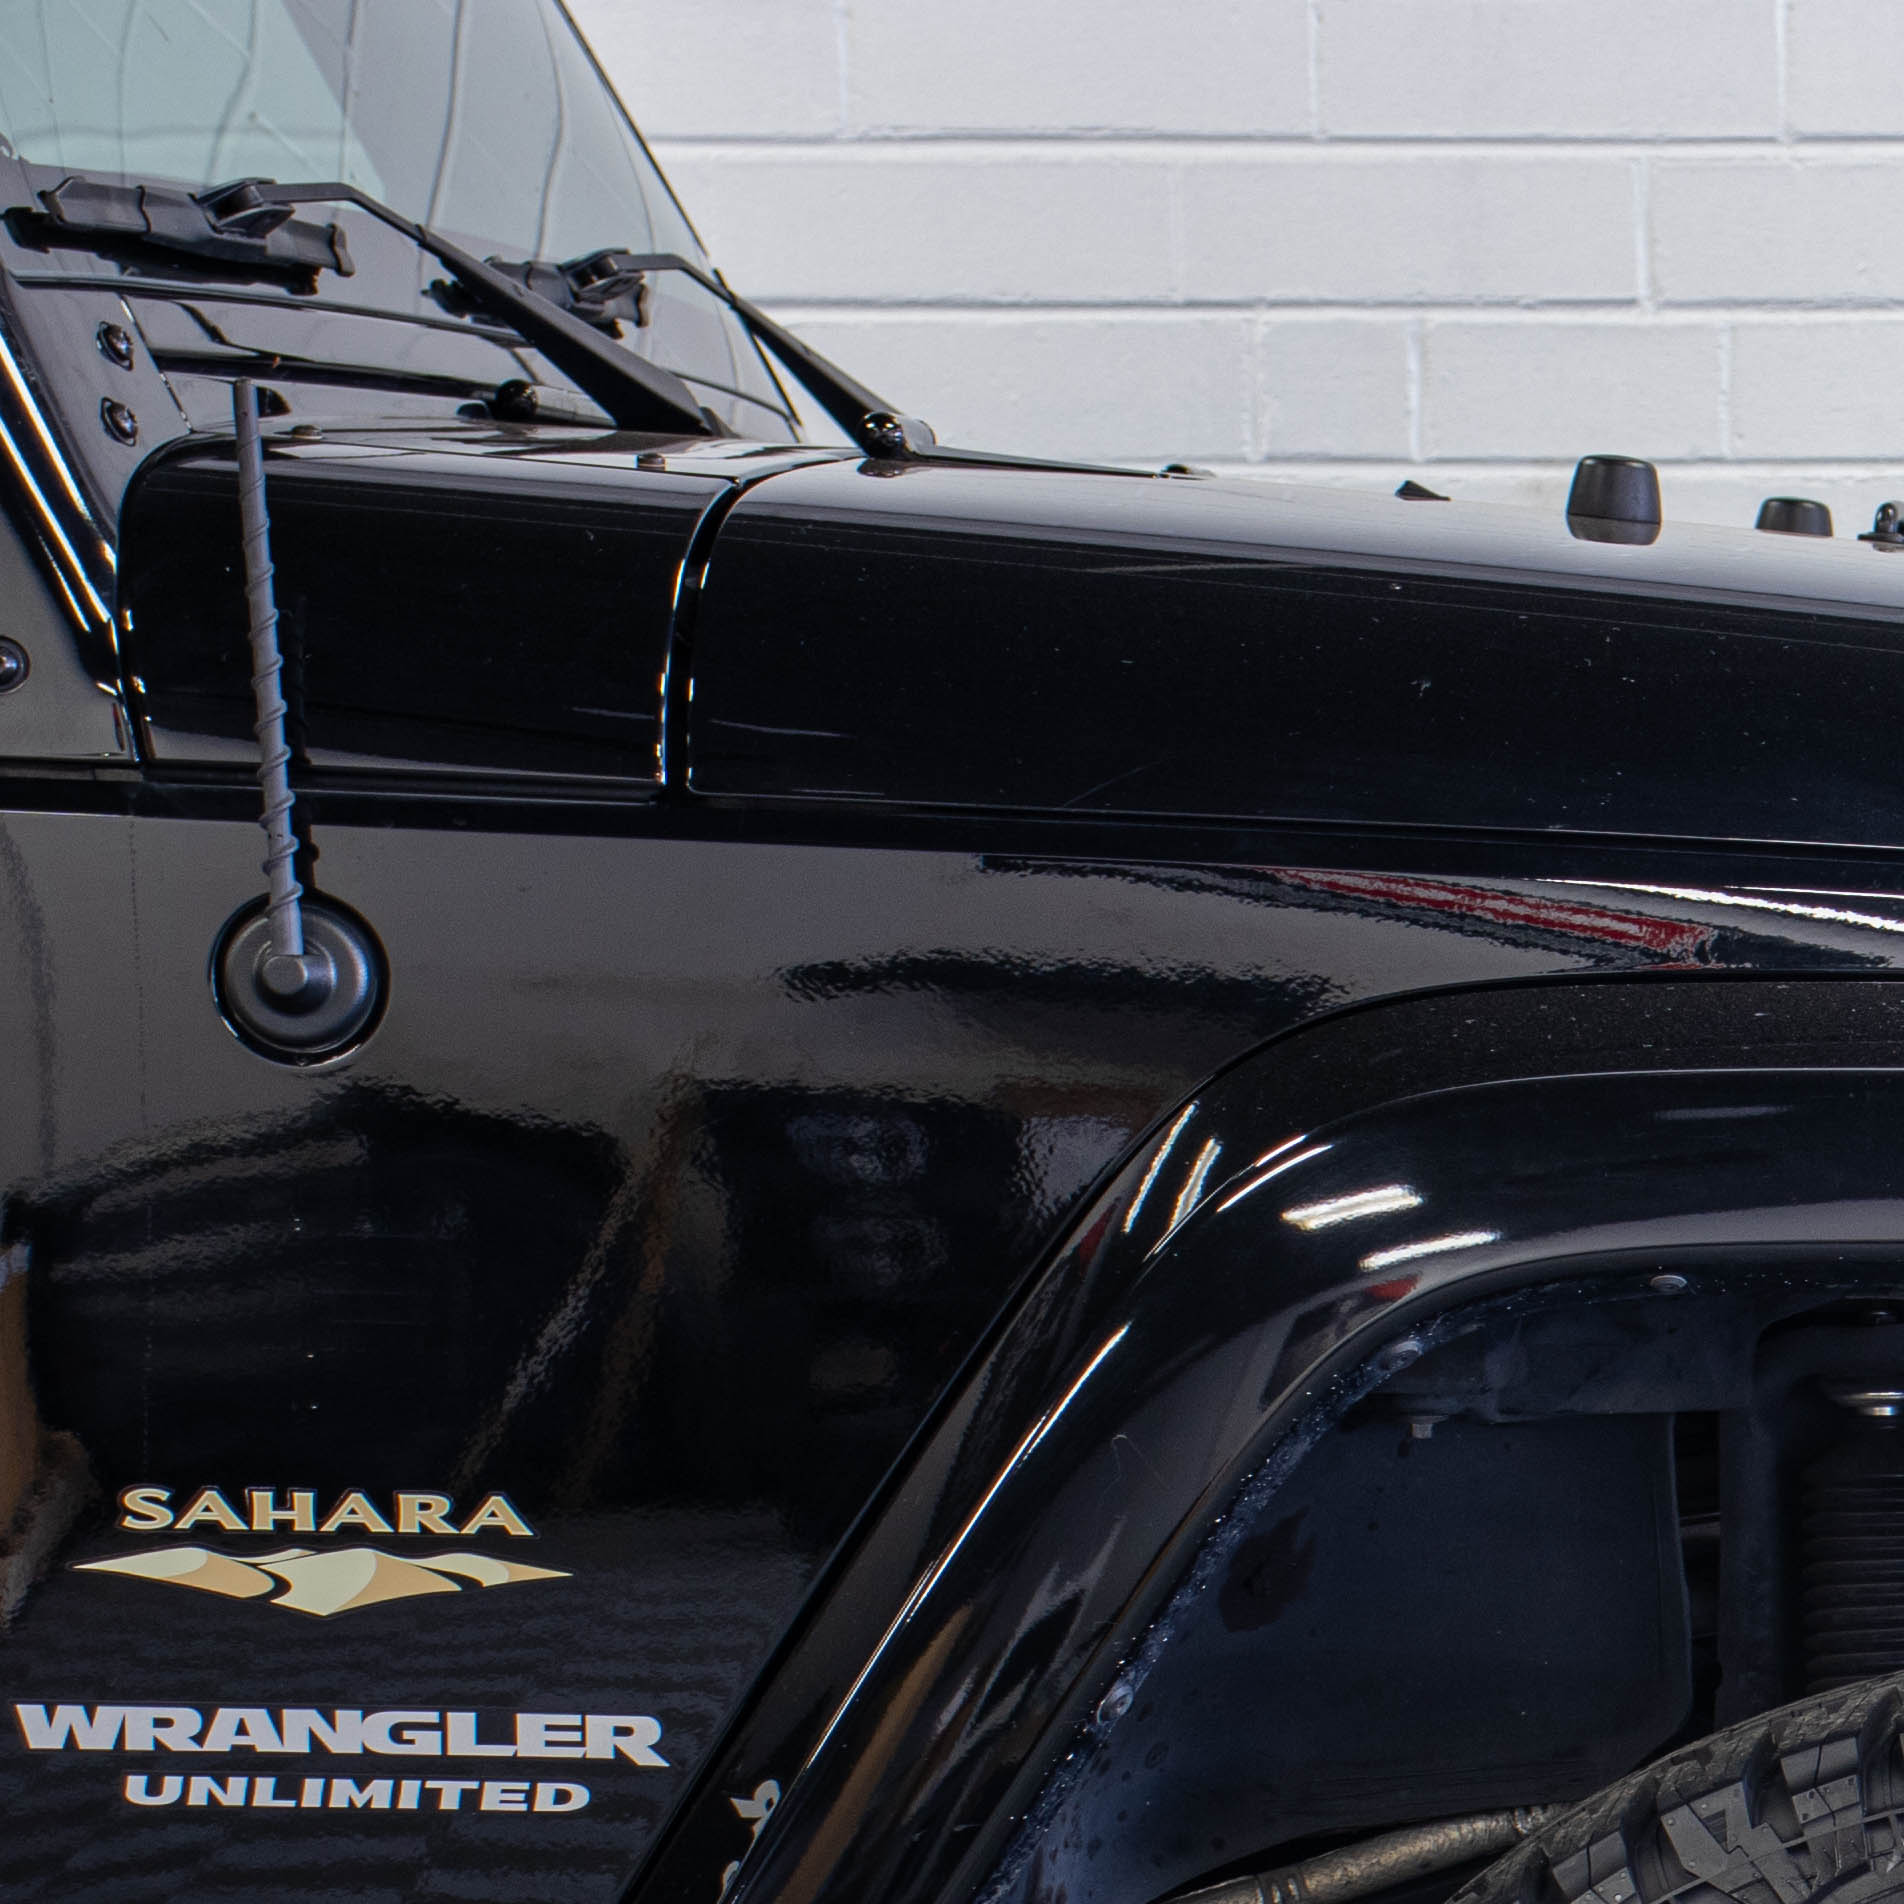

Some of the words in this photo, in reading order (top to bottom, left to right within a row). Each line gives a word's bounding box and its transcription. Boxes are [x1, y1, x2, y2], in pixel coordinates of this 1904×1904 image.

[118, 1485, 535, 1536] SAHARA
[16, 1704, 670, 1767] WRANGLER
[124, 1775, 591, 1812] UNLIMITED
